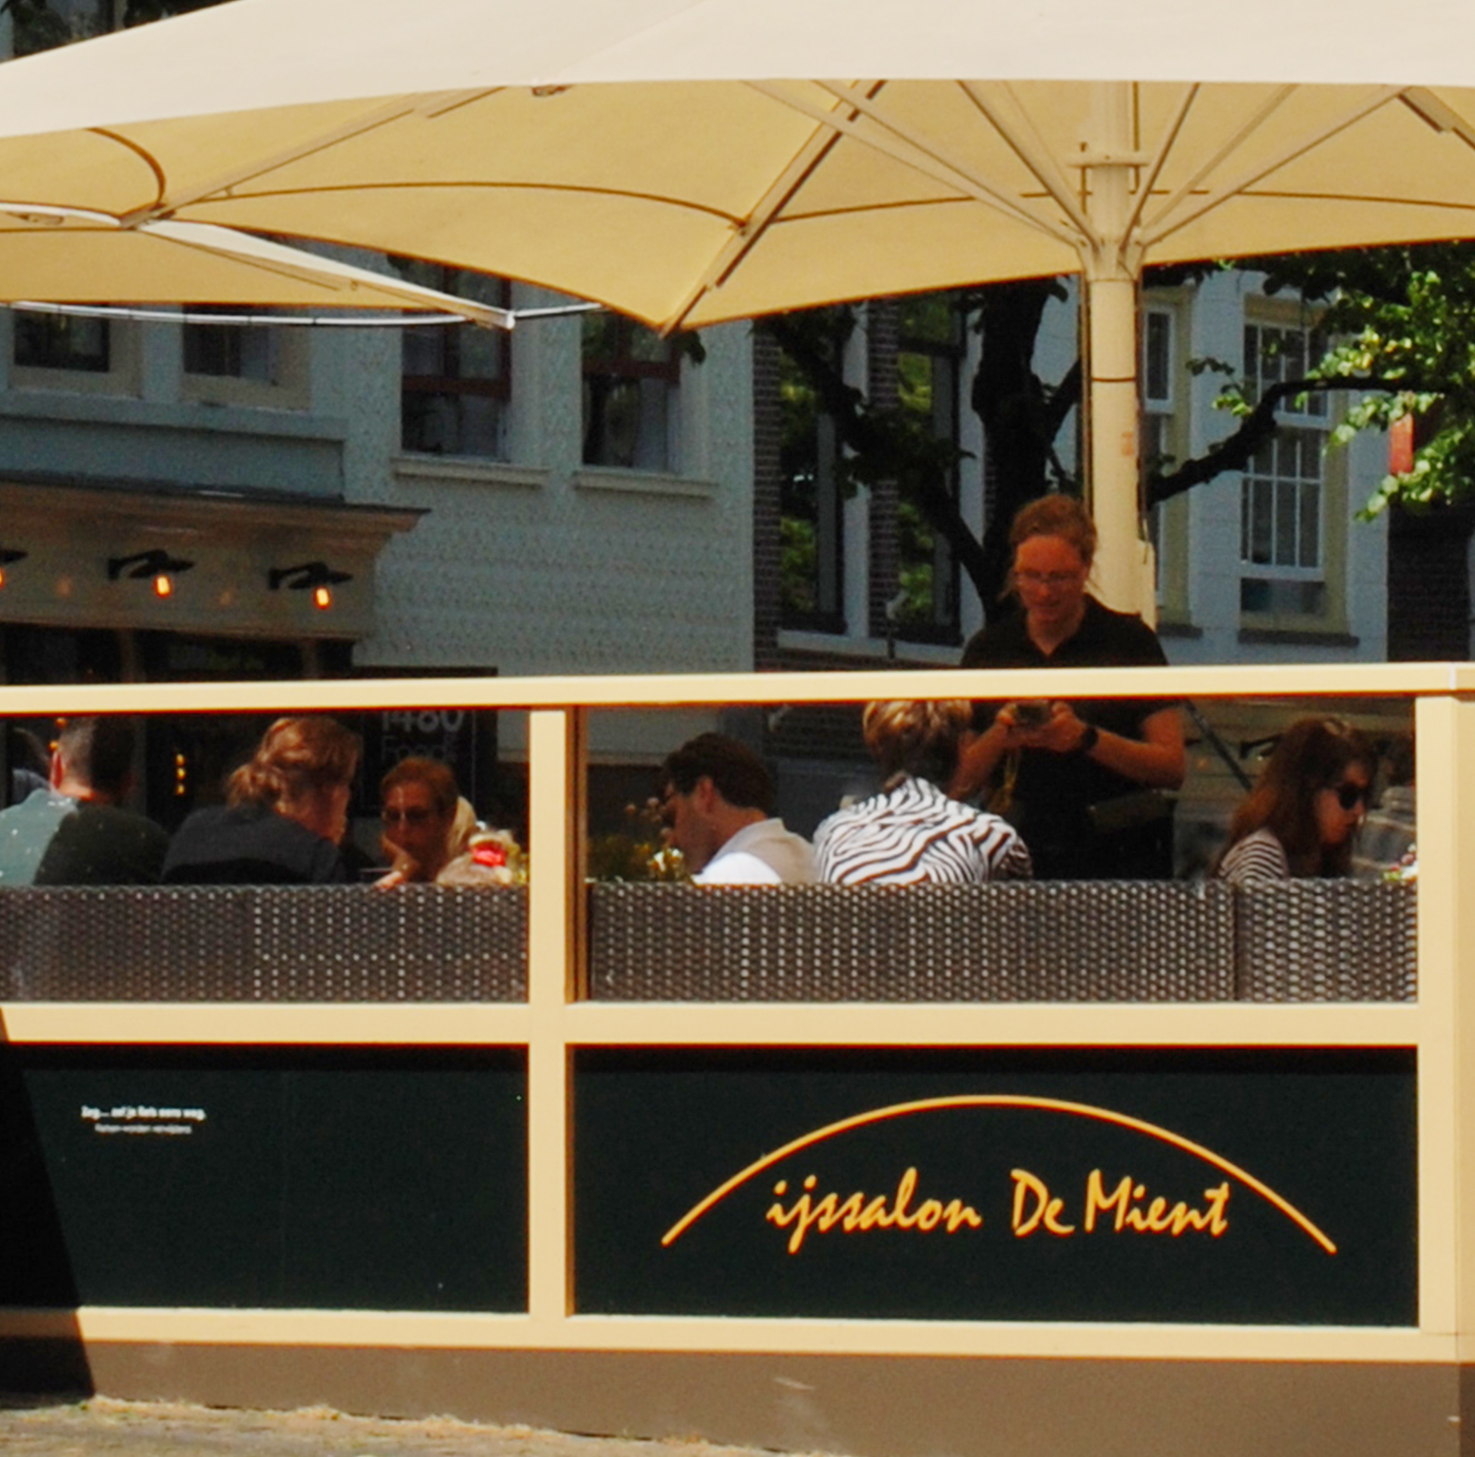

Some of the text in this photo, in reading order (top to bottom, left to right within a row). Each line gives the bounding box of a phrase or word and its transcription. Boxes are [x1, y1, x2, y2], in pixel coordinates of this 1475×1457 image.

[765, 1166, 1231, 1254] ijssalon De Mient
